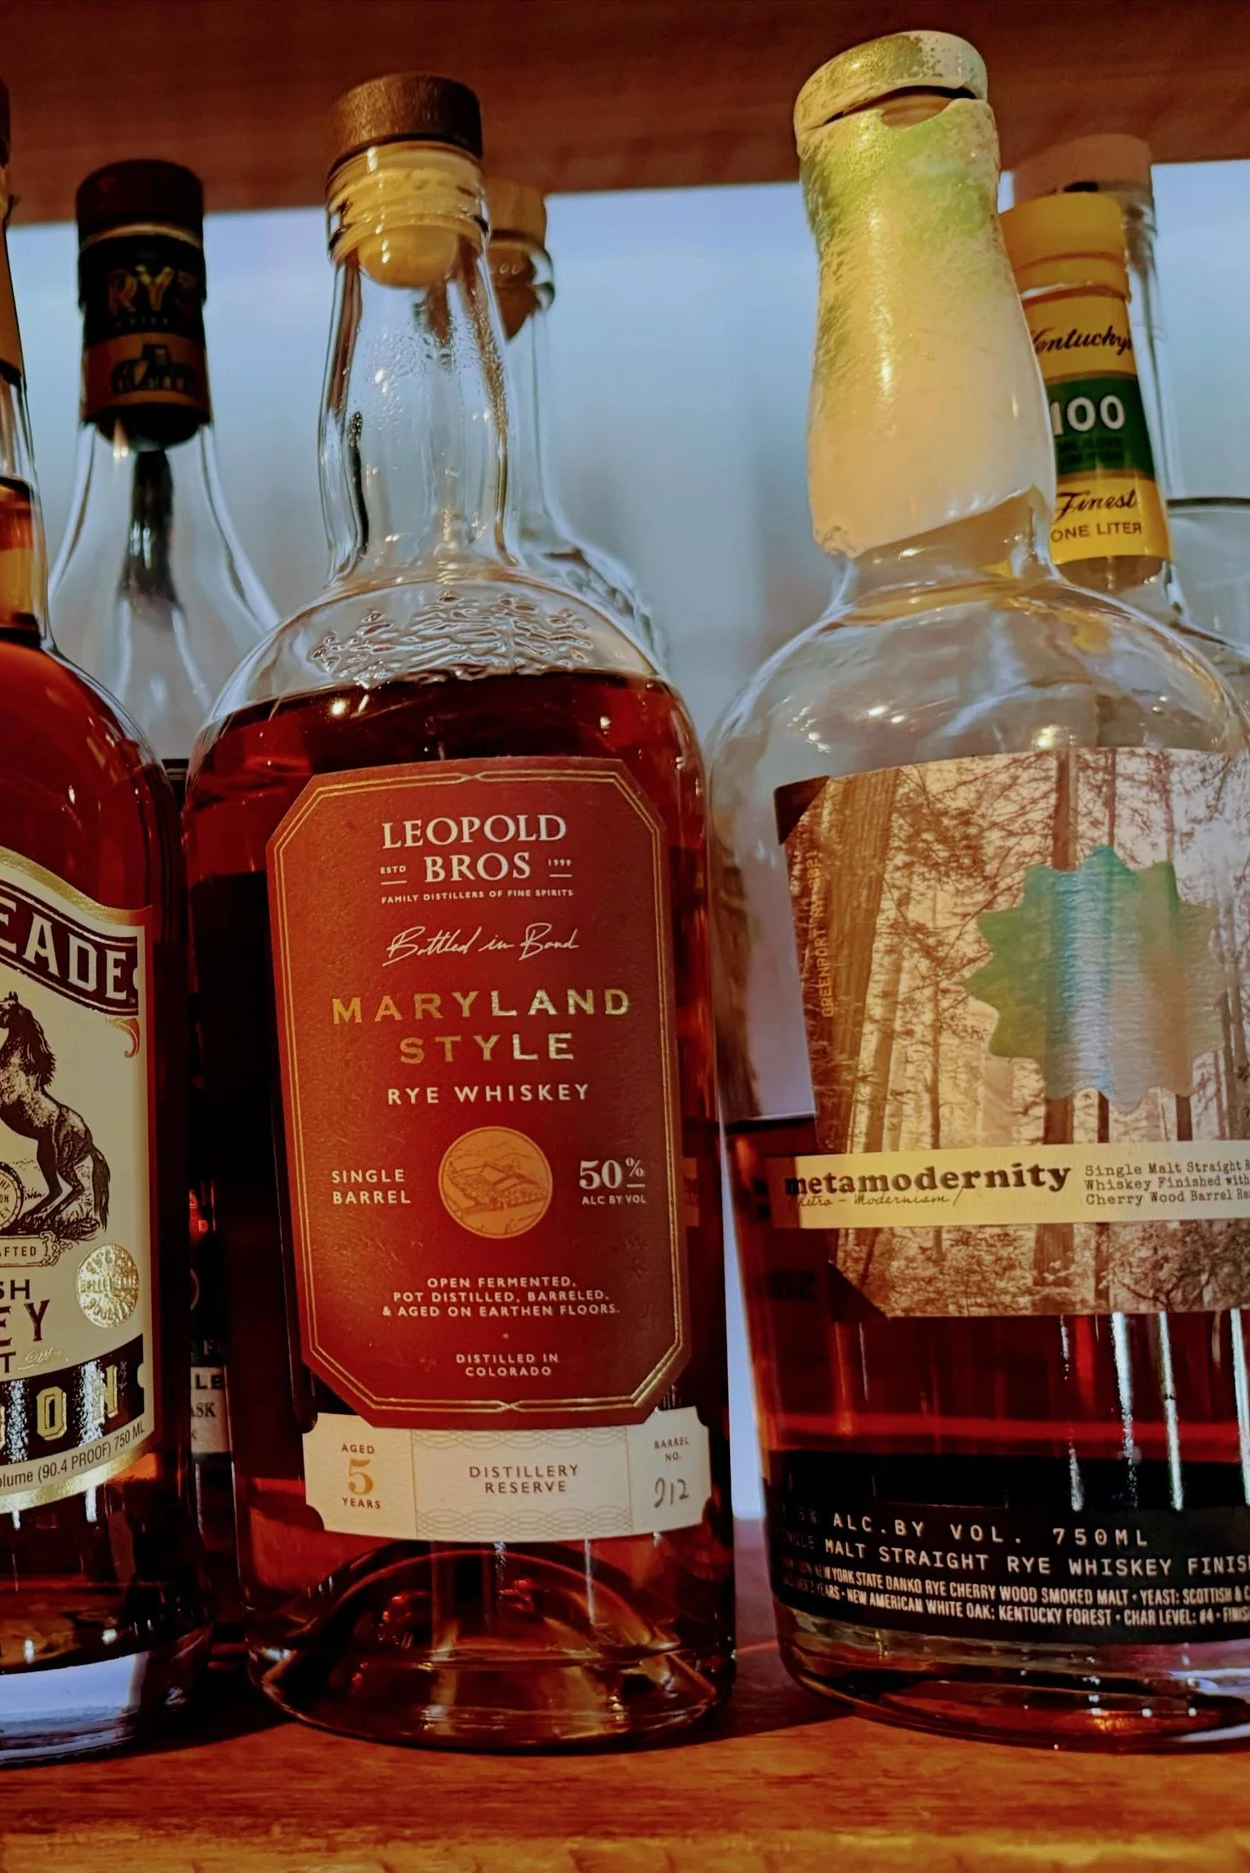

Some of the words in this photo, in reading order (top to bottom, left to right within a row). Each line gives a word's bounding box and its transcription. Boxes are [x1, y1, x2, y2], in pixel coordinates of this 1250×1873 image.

[1049, 394, 1126, 437] 100
[1053, 489, 1139, 522] Finest
[1050, 522, 1091, 543] ONE
[1096, 521, 1143, 536] LITER
[381, 814, 567, 849] LEOPOLD
[380, 865, 407, 875] ESTD
[423, 852, 531, 883] BROS
[381, 894, 419, 904] FAMILY
[423, 891, 485, 901] DISTILLERS
[489, 890, 503, 898] OF
[507, 889, 531, 898] FINE
[535, 888, 574, 898] SPIRITS
[382, 926, 483, 968] Bottled
[478, 934, 515, 952] in
[518, 922, 581, 962] Bond
[332, 988, 631, 1025] MARYLAND
[399, 1032, 575, 1065] STYLE
[386, 1086, 440, 1105] RYE
[454, 1083, 590, 1103] WHISKEY
[331, 1168, 406, 1184] SINGLE
[579, 1157, 645, 1190] 50%
[1085, 1163, 1143, 1178] Single
[1148, 1161, 1182, 1175] Malt
[1187, 1159, 1242, 1174] Straight
[784, 1162, 1071, 1196] metamodernity
[1084, 1178, 1151, 1192] Whiskey
[1158, 1174, 1221, 1189] Finished
[332, 1189, 412, 1206] BARREL
[581, 1195, 606, 1205] ALC
[608, 1195, 623, 1205] BY
[625, 1194, 647, 1204] VOL
[1085, 1193, 1144, 1207] Cherry
[1149, 1191, 1185, 1203] Wood
[1190, 1188, 1233, 1201] Barrel
[427, 1277, 471, 1288] OPEN
[393, 1291, 424, 1302] POT
[398, 1306, 440, 1317] AGED
[448, 1306, 472, 1317] ON
[479, 1305, 553, 1317] EARTHEN
[560, 1303, 621, 1316] FLOORS.
[456, 1353, 536, 1364] DISTILLED
[543, 1353, 559, 1363] IN
[465, 1366, 552, 1377] COLORADO
[340, 1443, 375, 1455] AGED
[653, 1436, 690, 1449] BARREL
[37, 1461, 68, 1484] (90.4
[71, 1441, 112, 1469] PROOF)
[114, 1433, 131, 1452] 750
[132, 1421, 146, 1440] ML
[346, 1458, 374, 1496] 5
[468, 1464, 580, 1479] DISTILLERY
[485, 1480, 567, 1495] RESERVE
[342, 1497, 382, 1510] YEARS
[1052, 1528, 1149, 1547] 750ML
[825, 1538, 867, 1559] MALT
[878, 1546, 989, 1571] STRAIGHT
[1007, 1555, 1052, 1574] RYE
[1068, 1557, 1172, 1576] WHISKEY
[855, 1572, 884, 1590] STATE
[885, 1575, 923, 1594] DANKO
[925, 1579, 948, 1597] RYE
[950, 1582, 996, 1601] CHERRY
[999, 1585, 1038, 1603] WOOD
[1041, 1587, 1093, 1605] SMOKED
[1096, 1588, 1129, 1606] MALT
[1139, 1588, 1180, 1606] YEAST:
[869, 1592, 924, 1614] AMERICAN
[925, 1599, 964, 1618] WHITE
[966, 1602, 996, 1621] OAK:
[998, 1604, 1063, 1626] KENTUCKY
[1065, 1608, 1113, 1626] FOREST
[1123, 1608, 1157, 1627] CHAR
[1158, 1607, 1197, 1627] LEVEL:
